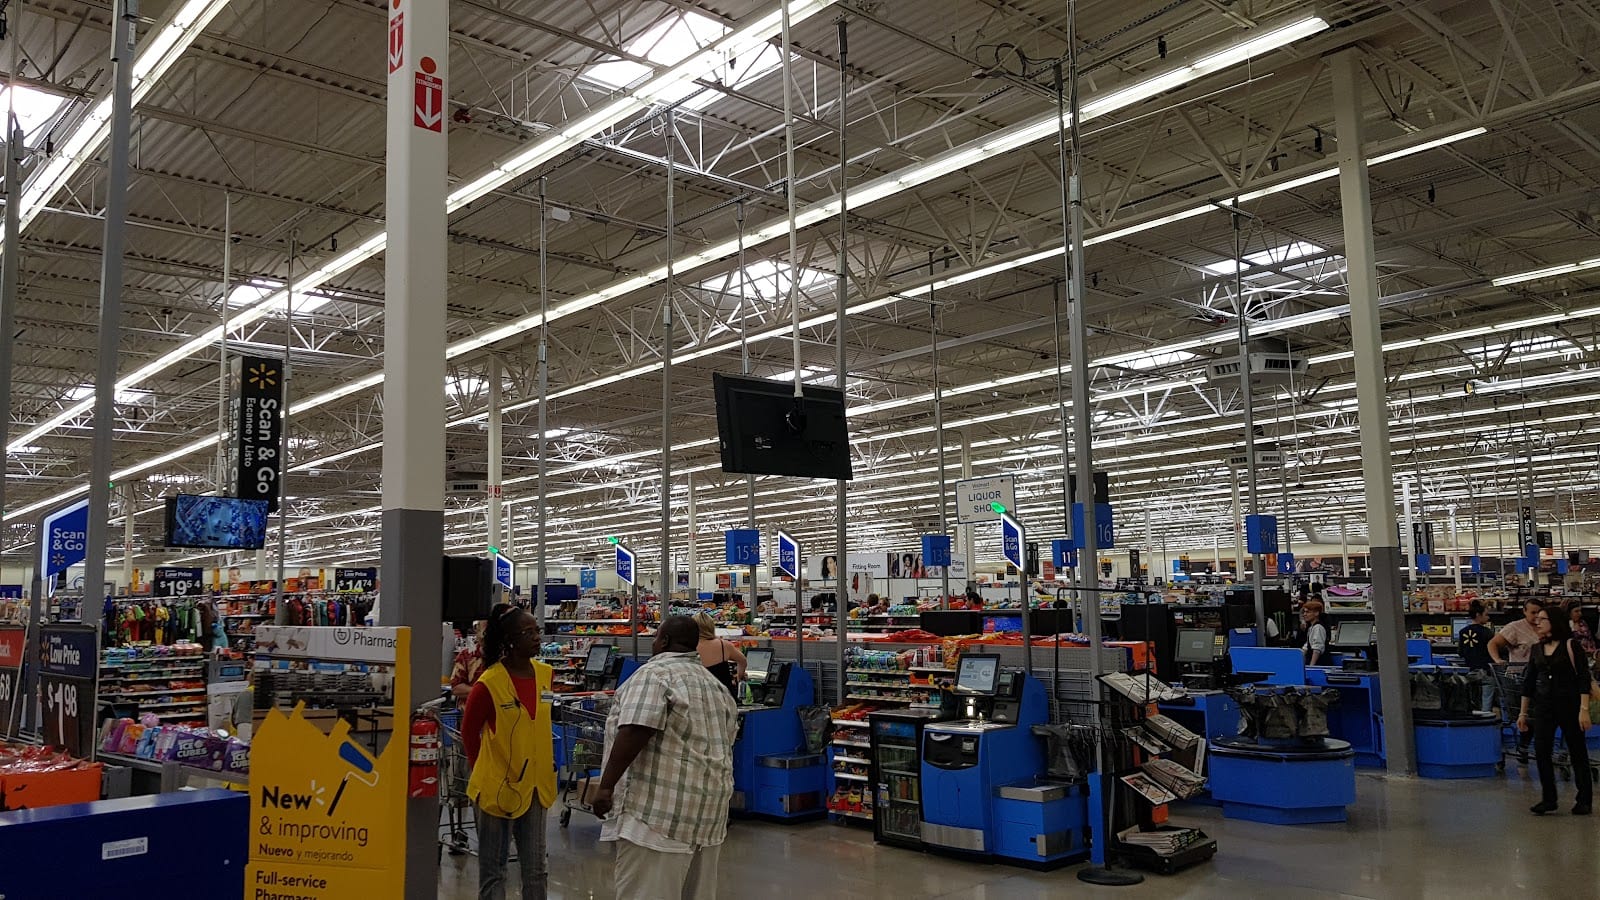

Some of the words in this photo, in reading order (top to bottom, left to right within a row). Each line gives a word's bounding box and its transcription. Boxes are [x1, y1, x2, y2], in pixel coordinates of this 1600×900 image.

[245, 398, 256, 435] Escanee
[259, 398, 278, 441] Scan
[245, 446, 254, 467] Listo
[258, 447, 275, 460] &
[257, 466, 275, 494] Go
[968, 491, 1001, 502] LIQUOR
[974, 504, 992, 513] SHO
[53, 528, 85, 540] Scan
[1005, 535, 1018, 543] Scan
[1098, 523, 1112, 543] 16
[736, 545, 749, 561] 15
[932, 549, 943, 562] 13
[1062, 551, 1071, 564] 11
[852, 563, 867, 571] Fitting
[867, 562, 881, 570] Room
[1285, 561, 1291, 571] 9
[353, 631, 398, 648] Pharmac
[50, 644, 63, 664] Low
[63, 644, 80, 666] Price
[178, 739, 195, 752] ICE
[176, 747, 209, 759] CUBES
[231, 758, 249, 769] CUB
[262, 785, 312, 811] New
[259, 816, 272, 836] &
[279, 817, 368, 848] improving
[259, 843, 294, 858] Nuevo
[297, 850, 304, 861] y
[305, 849, 354, 863] mejorando
[256, 870, 327, 889] Full-service
